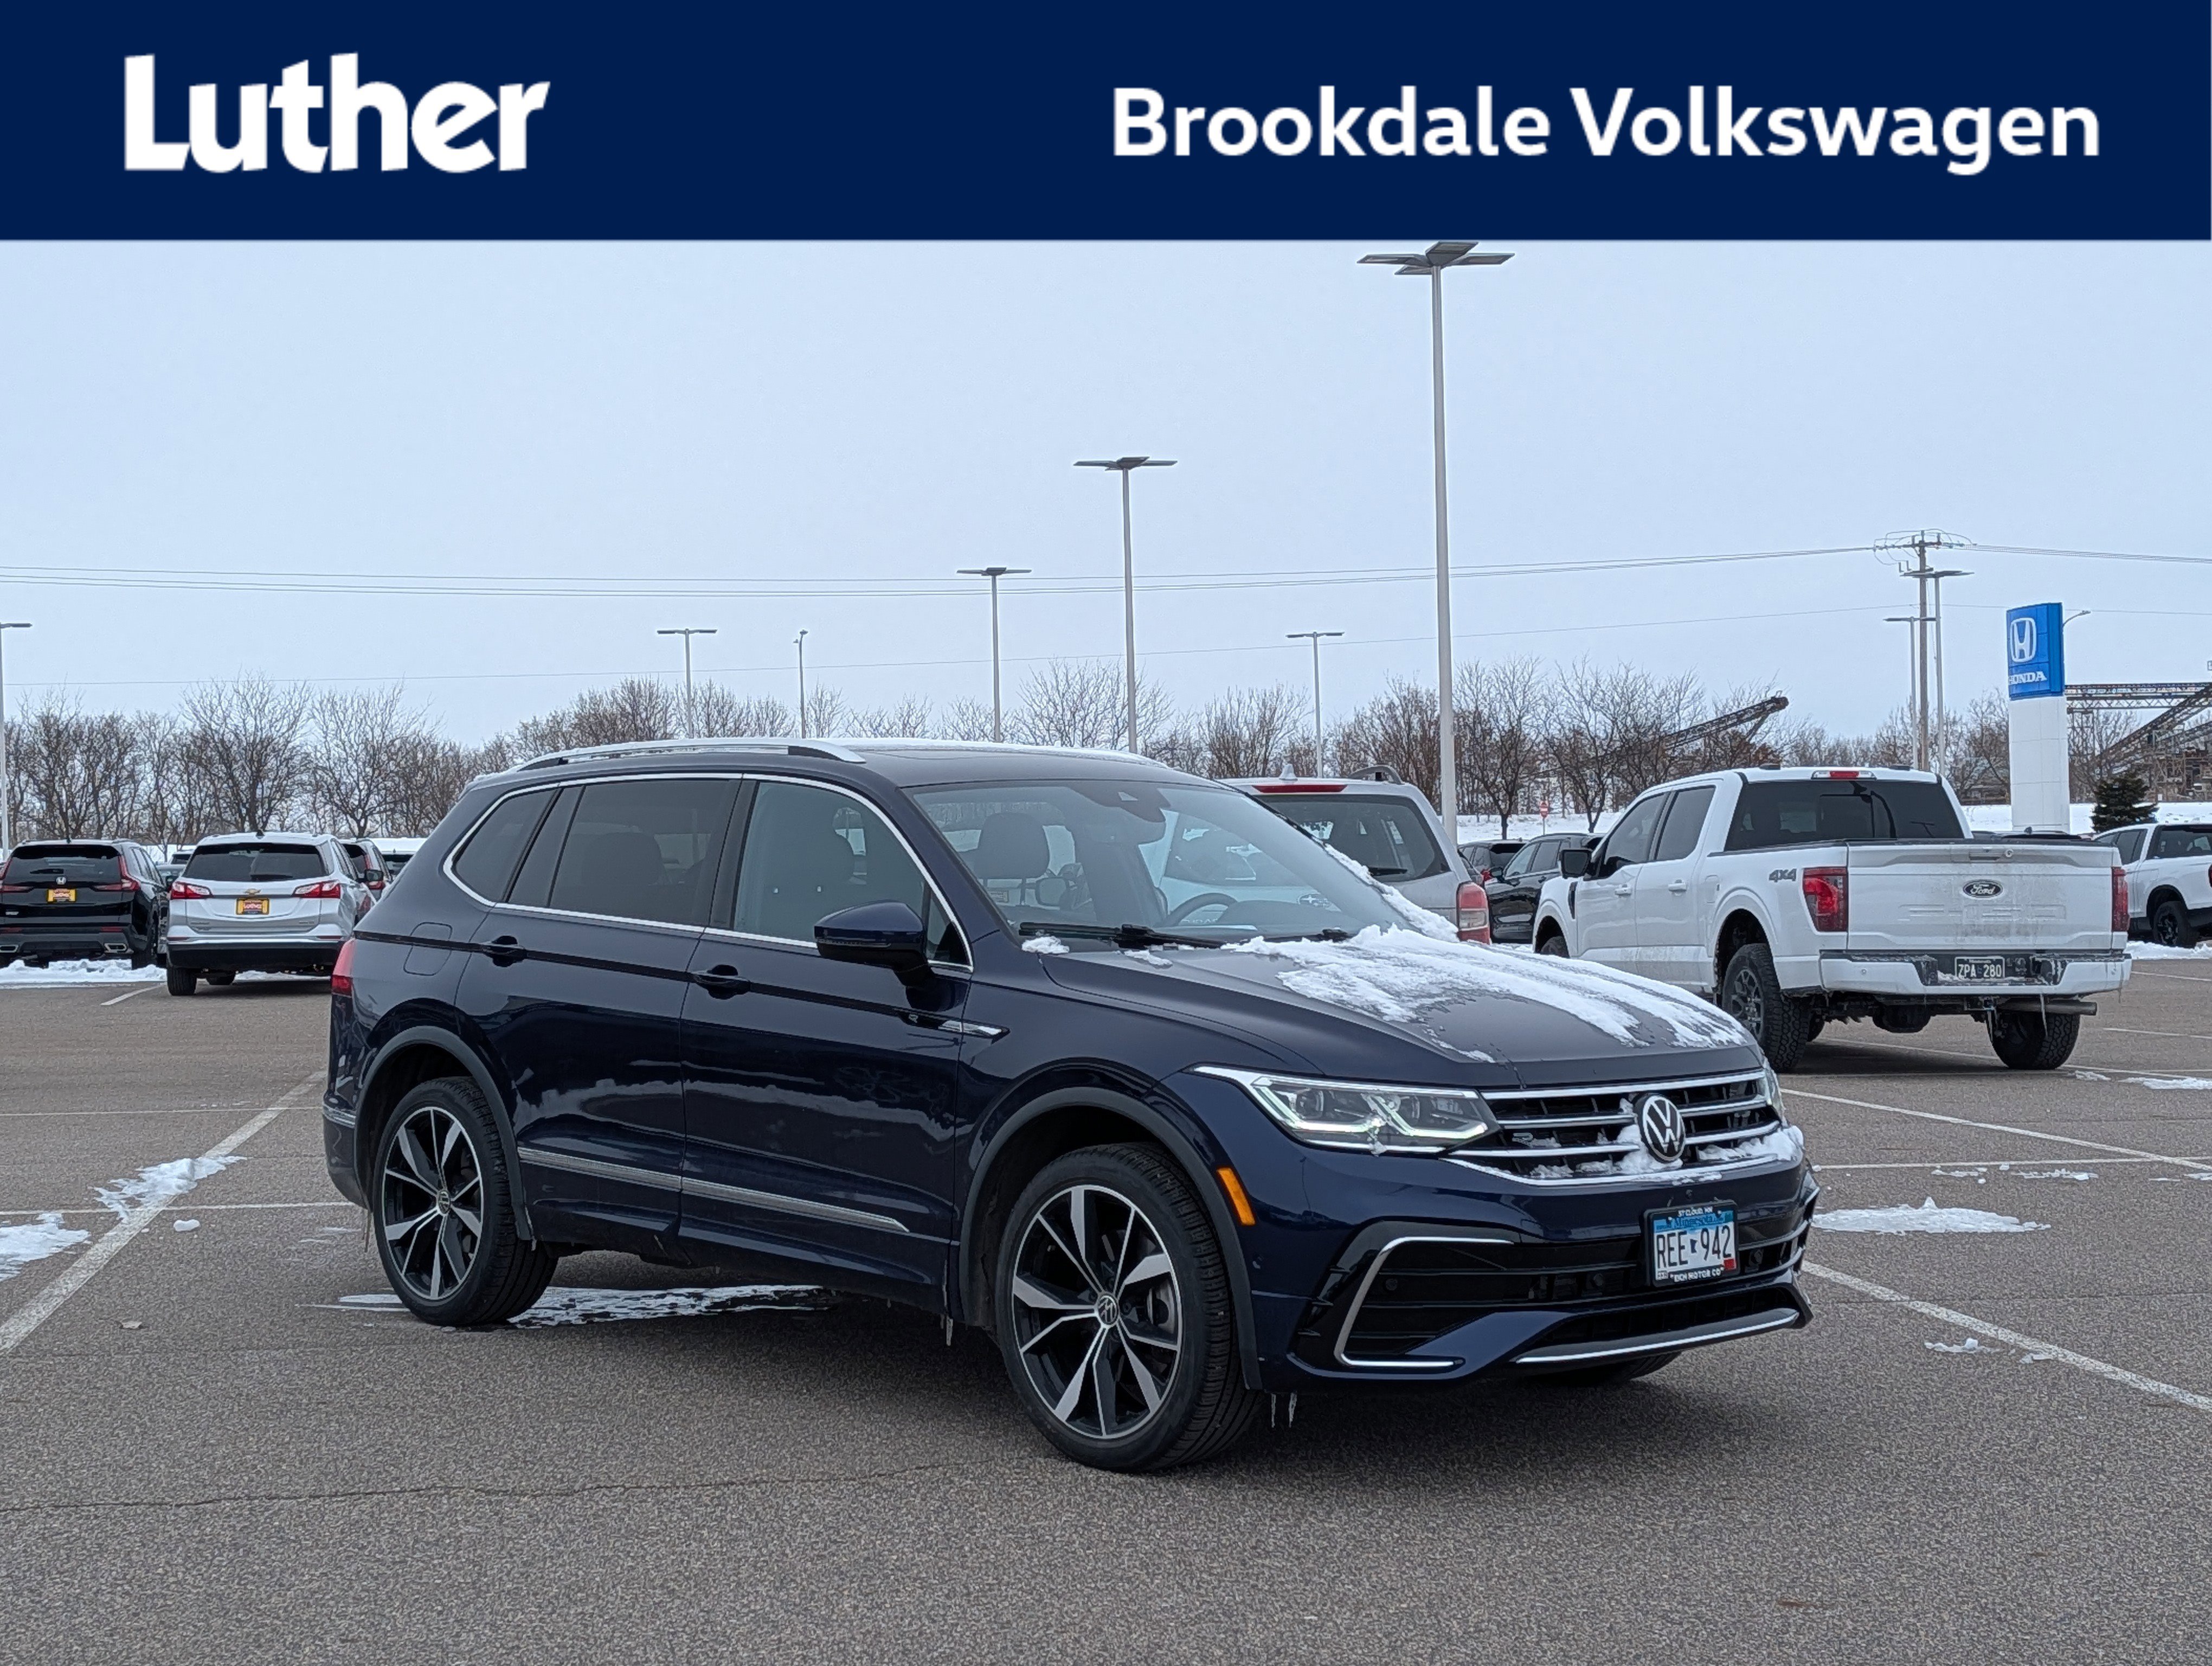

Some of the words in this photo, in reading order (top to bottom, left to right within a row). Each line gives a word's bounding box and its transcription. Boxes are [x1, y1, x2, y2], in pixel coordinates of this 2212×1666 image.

[2009, 671, 2047, 685] HONDA
[1970, 883, 1996, 894] Ford
[1958, 964, 1976, 978] ZPA
[1983, 964, 2002, 977] 280
[1657, 1231, 1688, 1268] REE
[1701, 1225, 1731, 1261] 942
